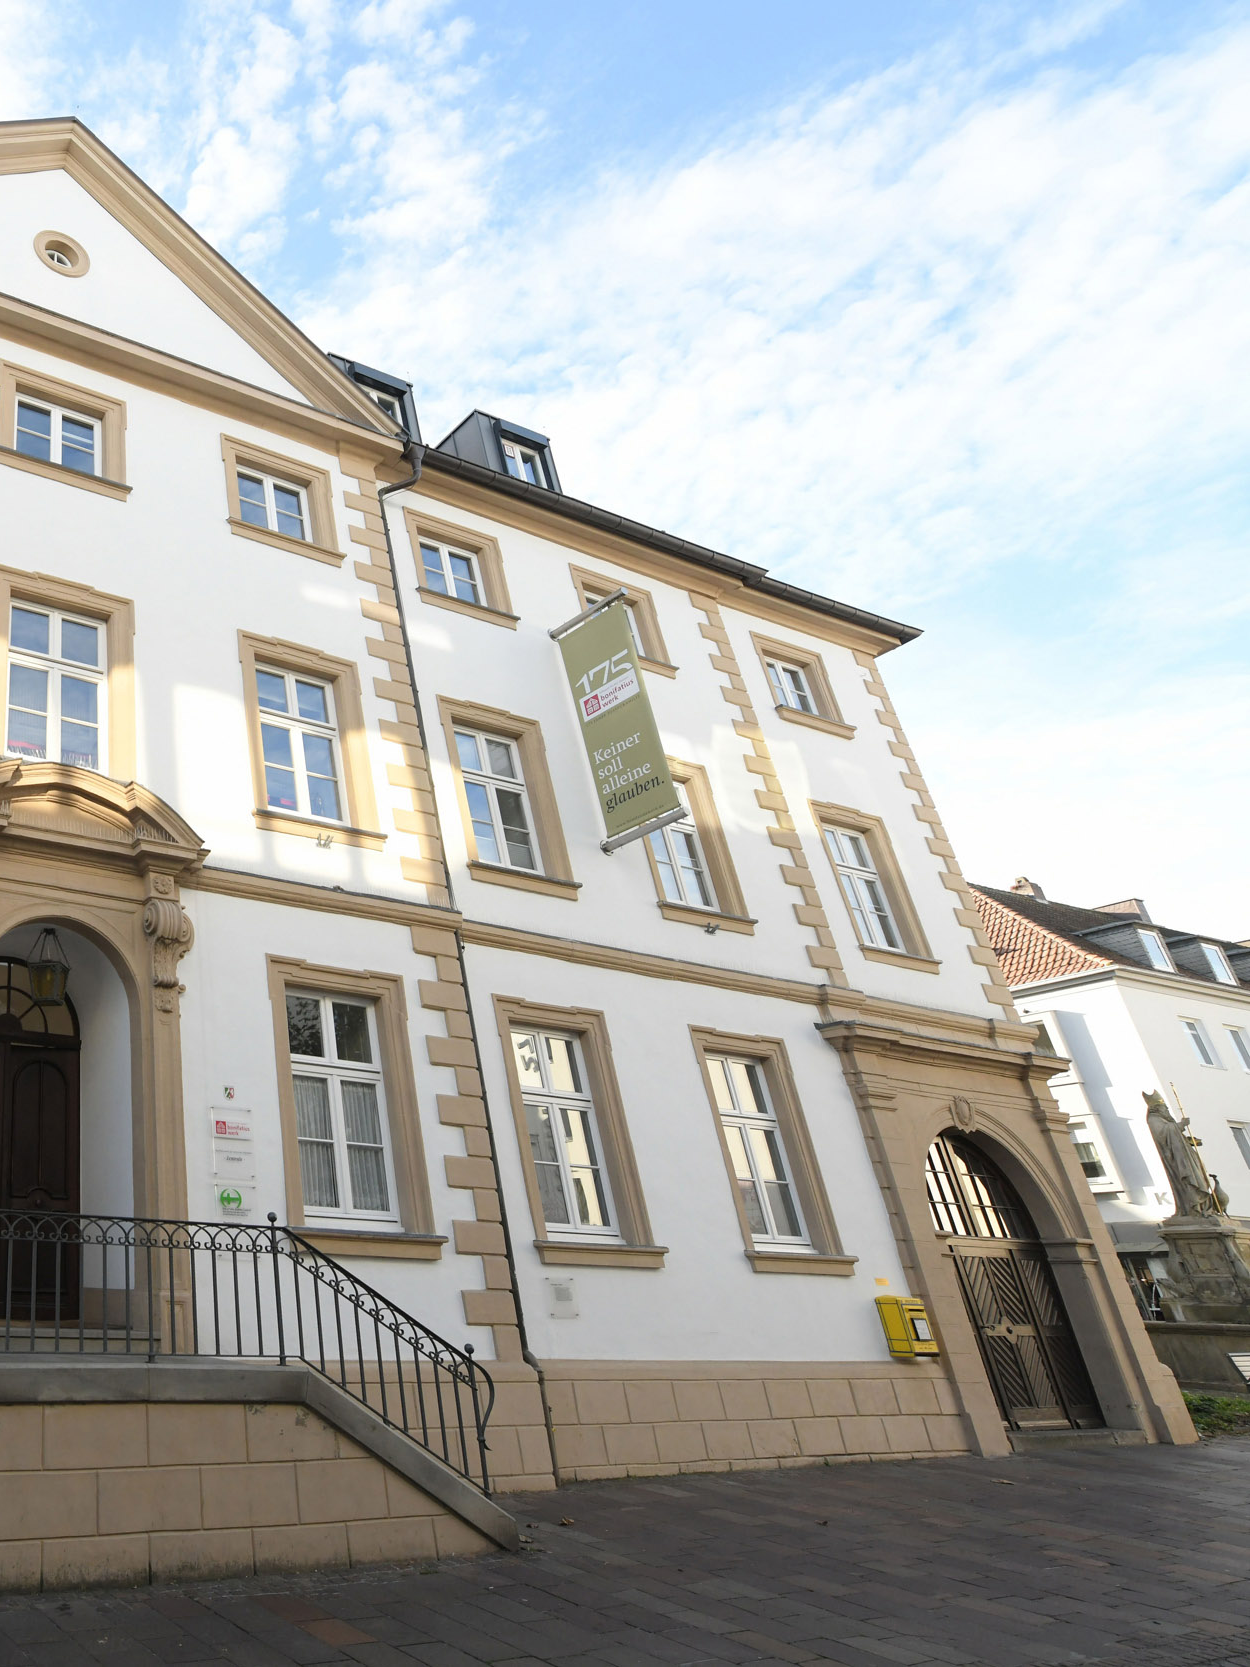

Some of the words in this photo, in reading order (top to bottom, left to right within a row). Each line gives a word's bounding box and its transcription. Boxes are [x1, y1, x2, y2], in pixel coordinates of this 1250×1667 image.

[575, 648, 633, 694] 175
[600, 678, 634, 701] bonifatius
[602, 695, 619, 708] werk
[593, 732, 641, 764] Keiner
[598, 757, 623, 779] soll
[602, 763, 652, 794] alleine
[606, 776, 664, 814] glauben.
